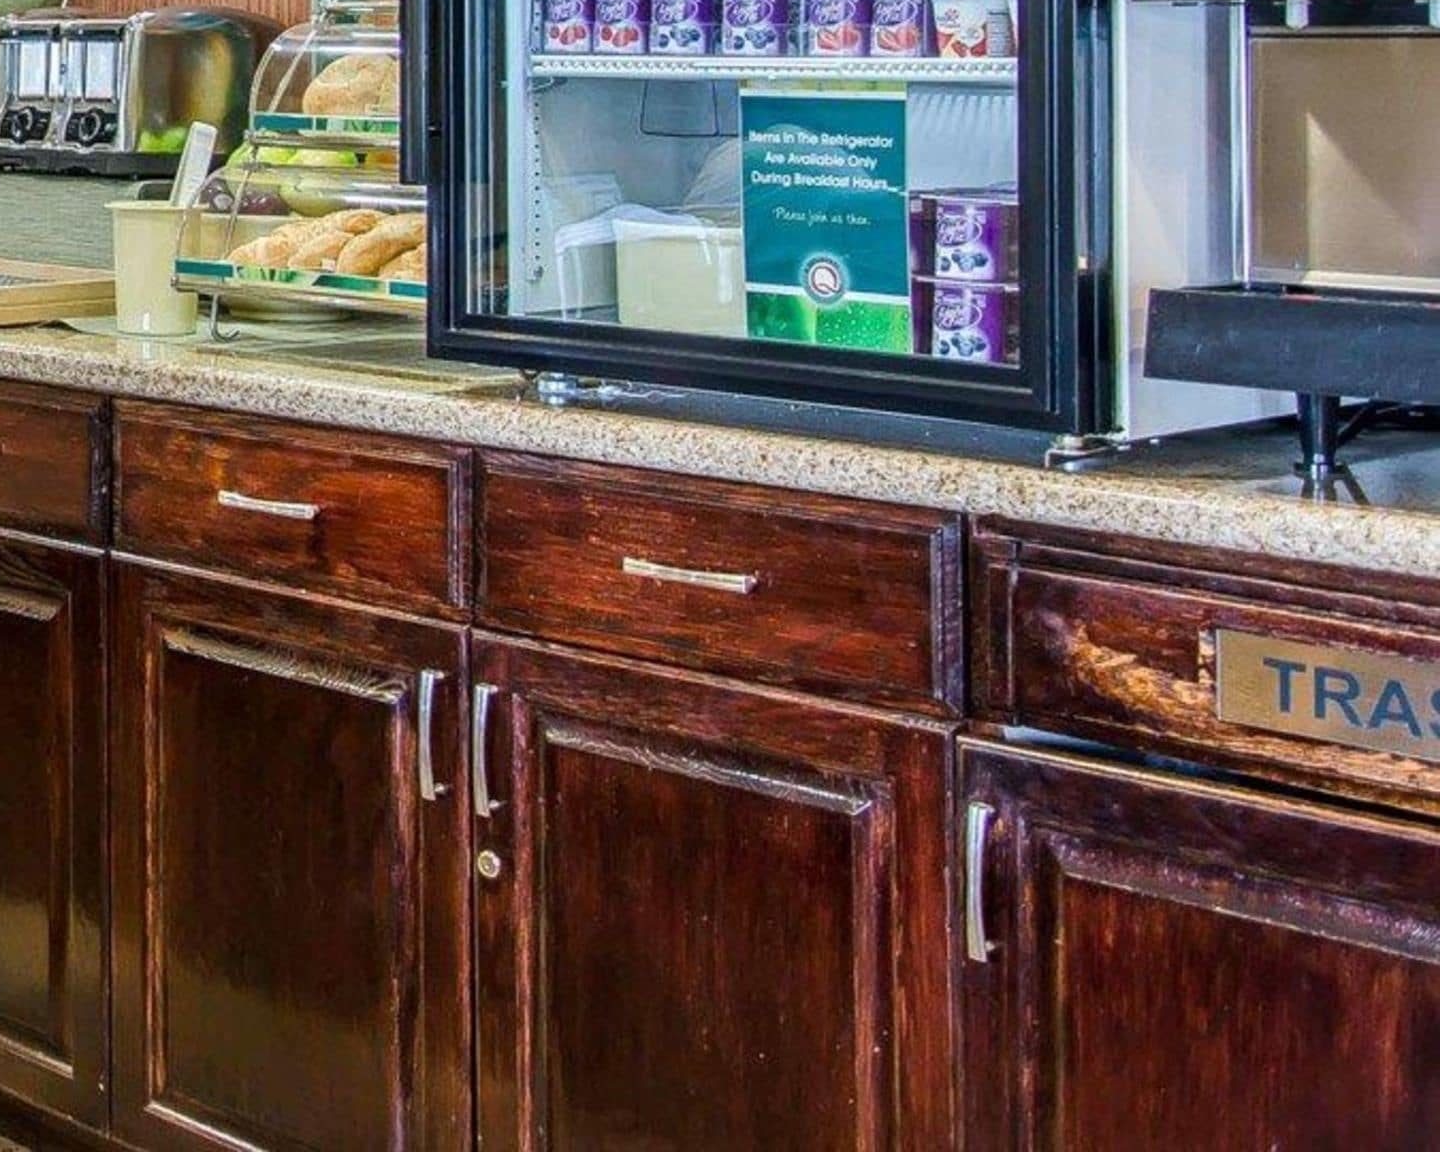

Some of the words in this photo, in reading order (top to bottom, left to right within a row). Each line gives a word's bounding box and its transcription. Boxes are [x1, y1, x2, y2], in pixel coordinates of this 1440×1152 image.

[748, 130, 781, 144] Items
[783, 132, 795, 144] In
[797, 132, 819, 145] The
[820, 134, 894, 149] Refrigerator
[764, 151, 785, 164] Are
[787, 152, 845, 168] Available
[847, 155, 878, 171] Only
[751, 170, 792, 187] During
[793, 173, 850, 188] Breakfast
[1262, 656, 1440, 740] TRA
